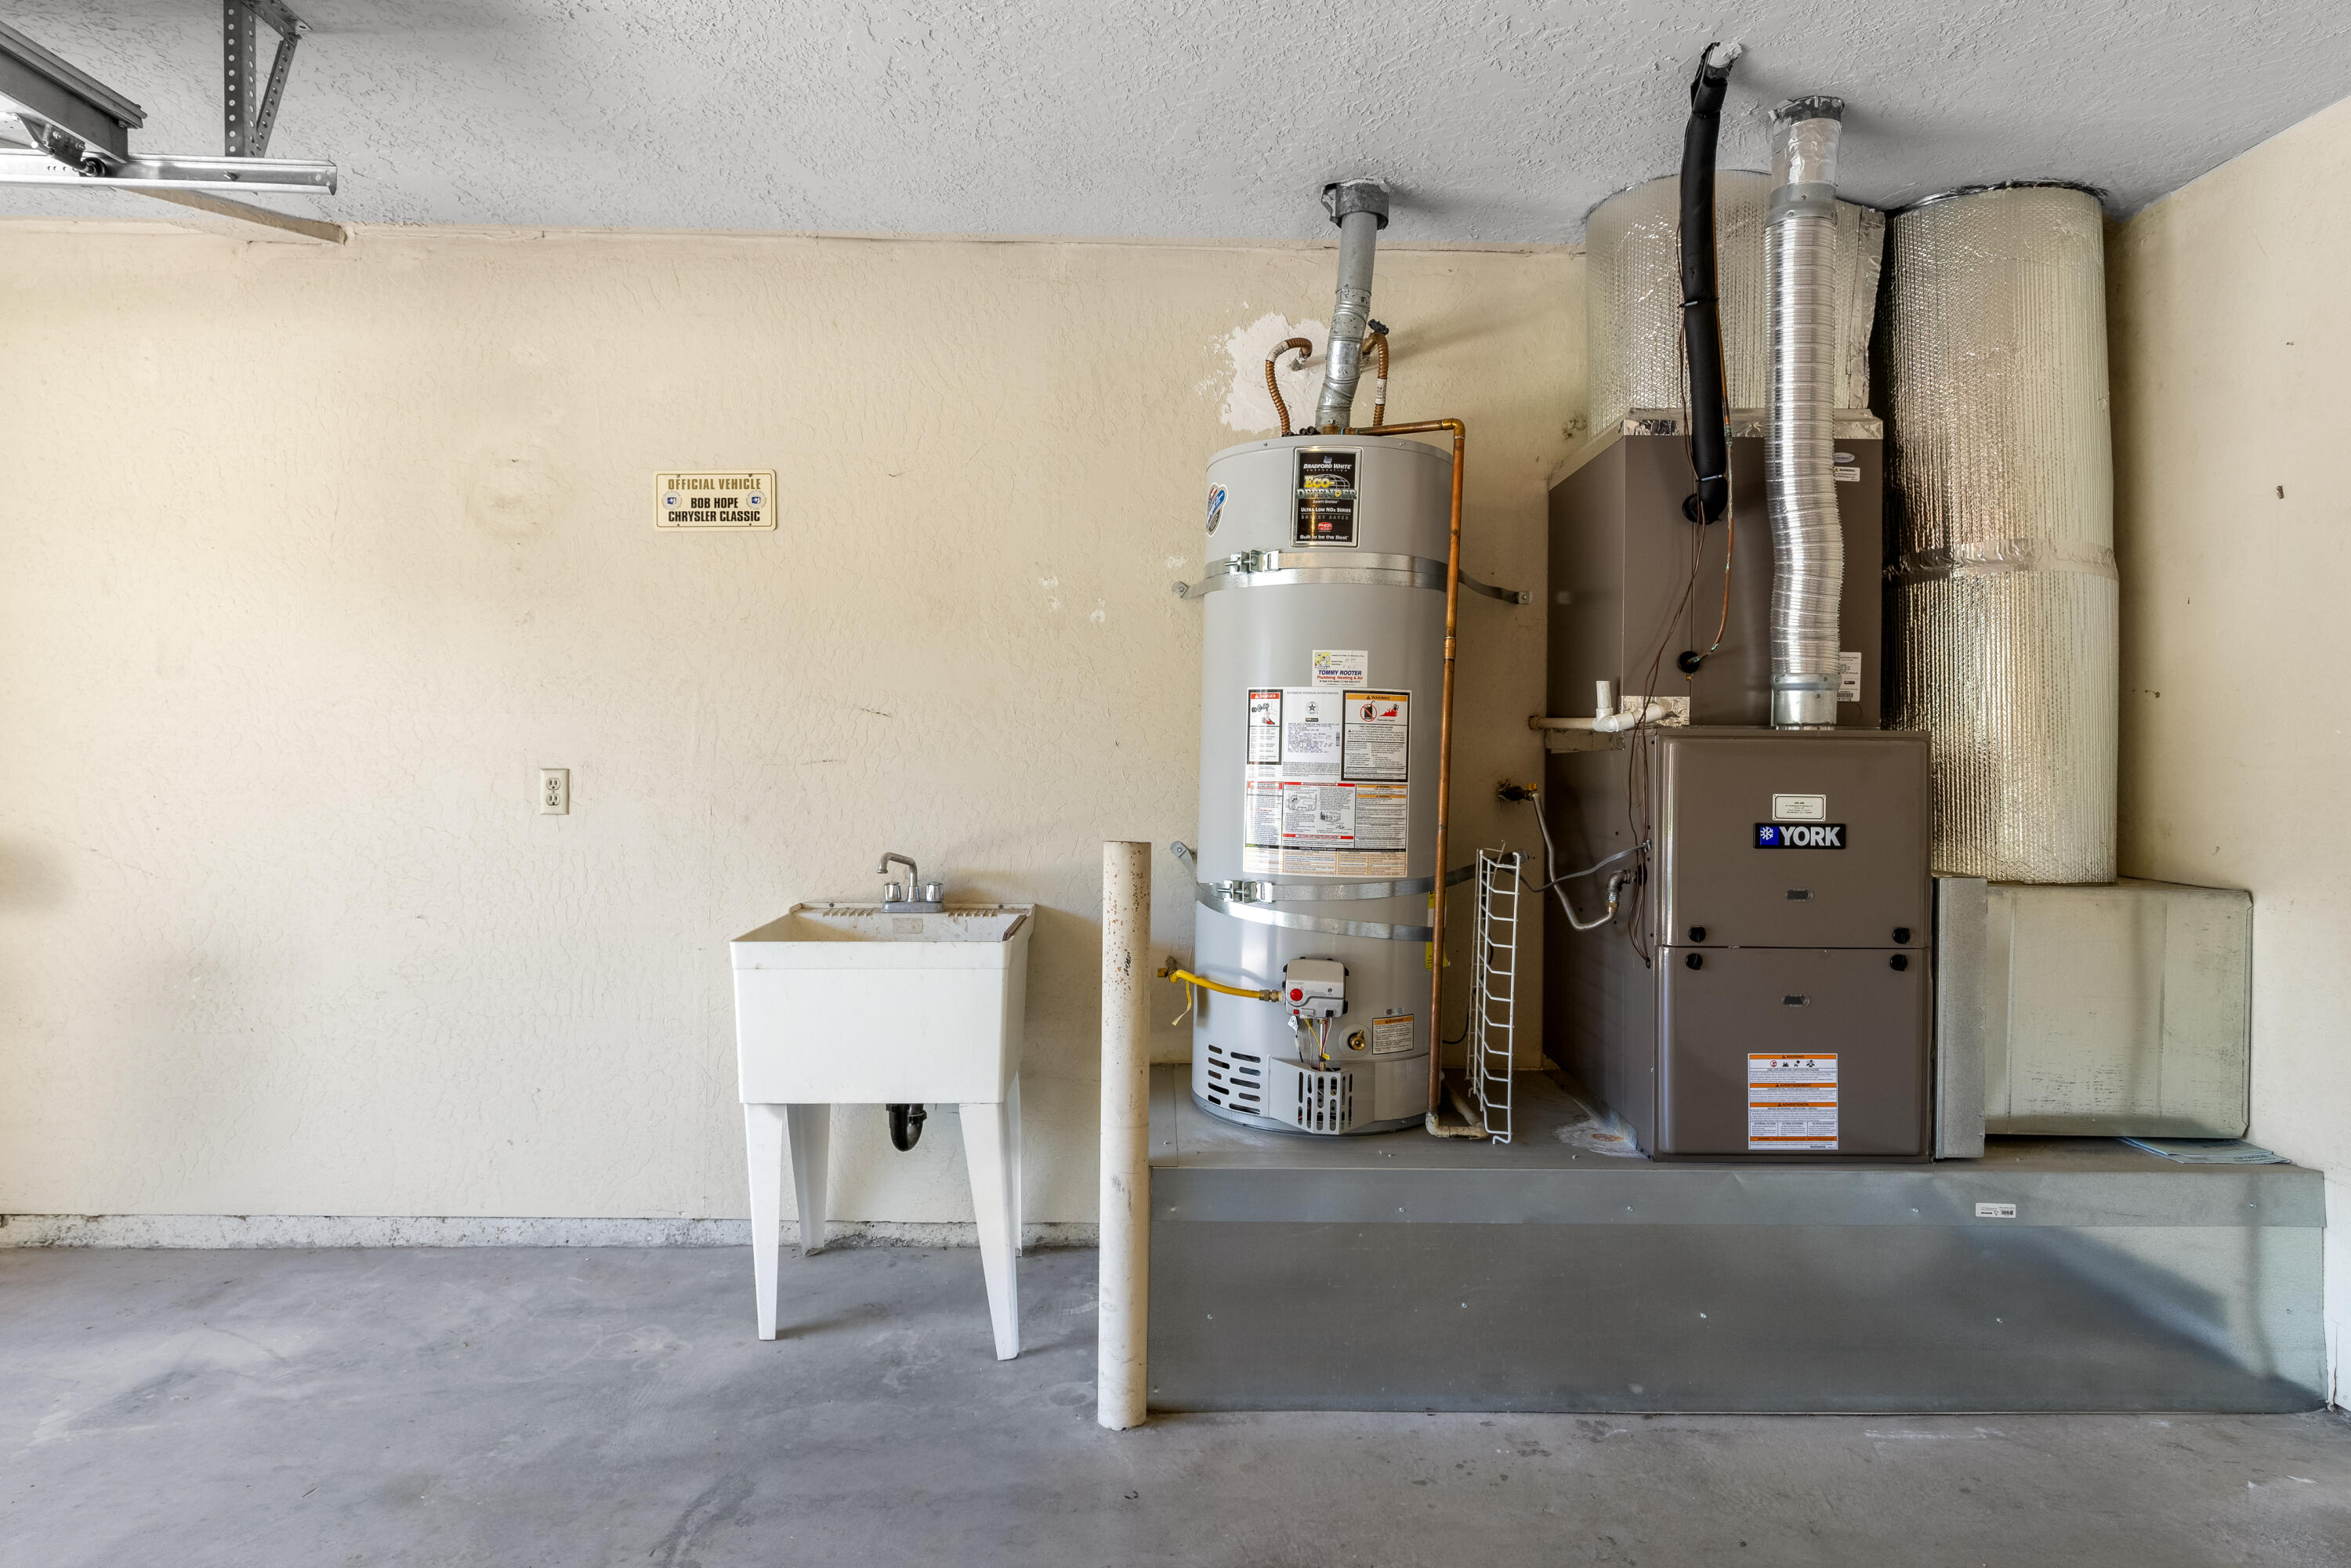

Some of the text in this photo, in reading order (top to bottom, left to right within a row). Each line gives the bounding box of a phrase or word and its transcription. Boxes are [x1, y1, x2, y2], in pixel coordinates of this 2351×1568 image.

[668, 479, 761, 490] OFFICIAL VEHICLE
[1296, 489, 1357, 499] DEFENDER
[690, 498, 738, 509] BOB HOPE
[668, 511, 760, 522] CHRYSLER CLASSIC
[1779, 826, 1841, 846] YORK
